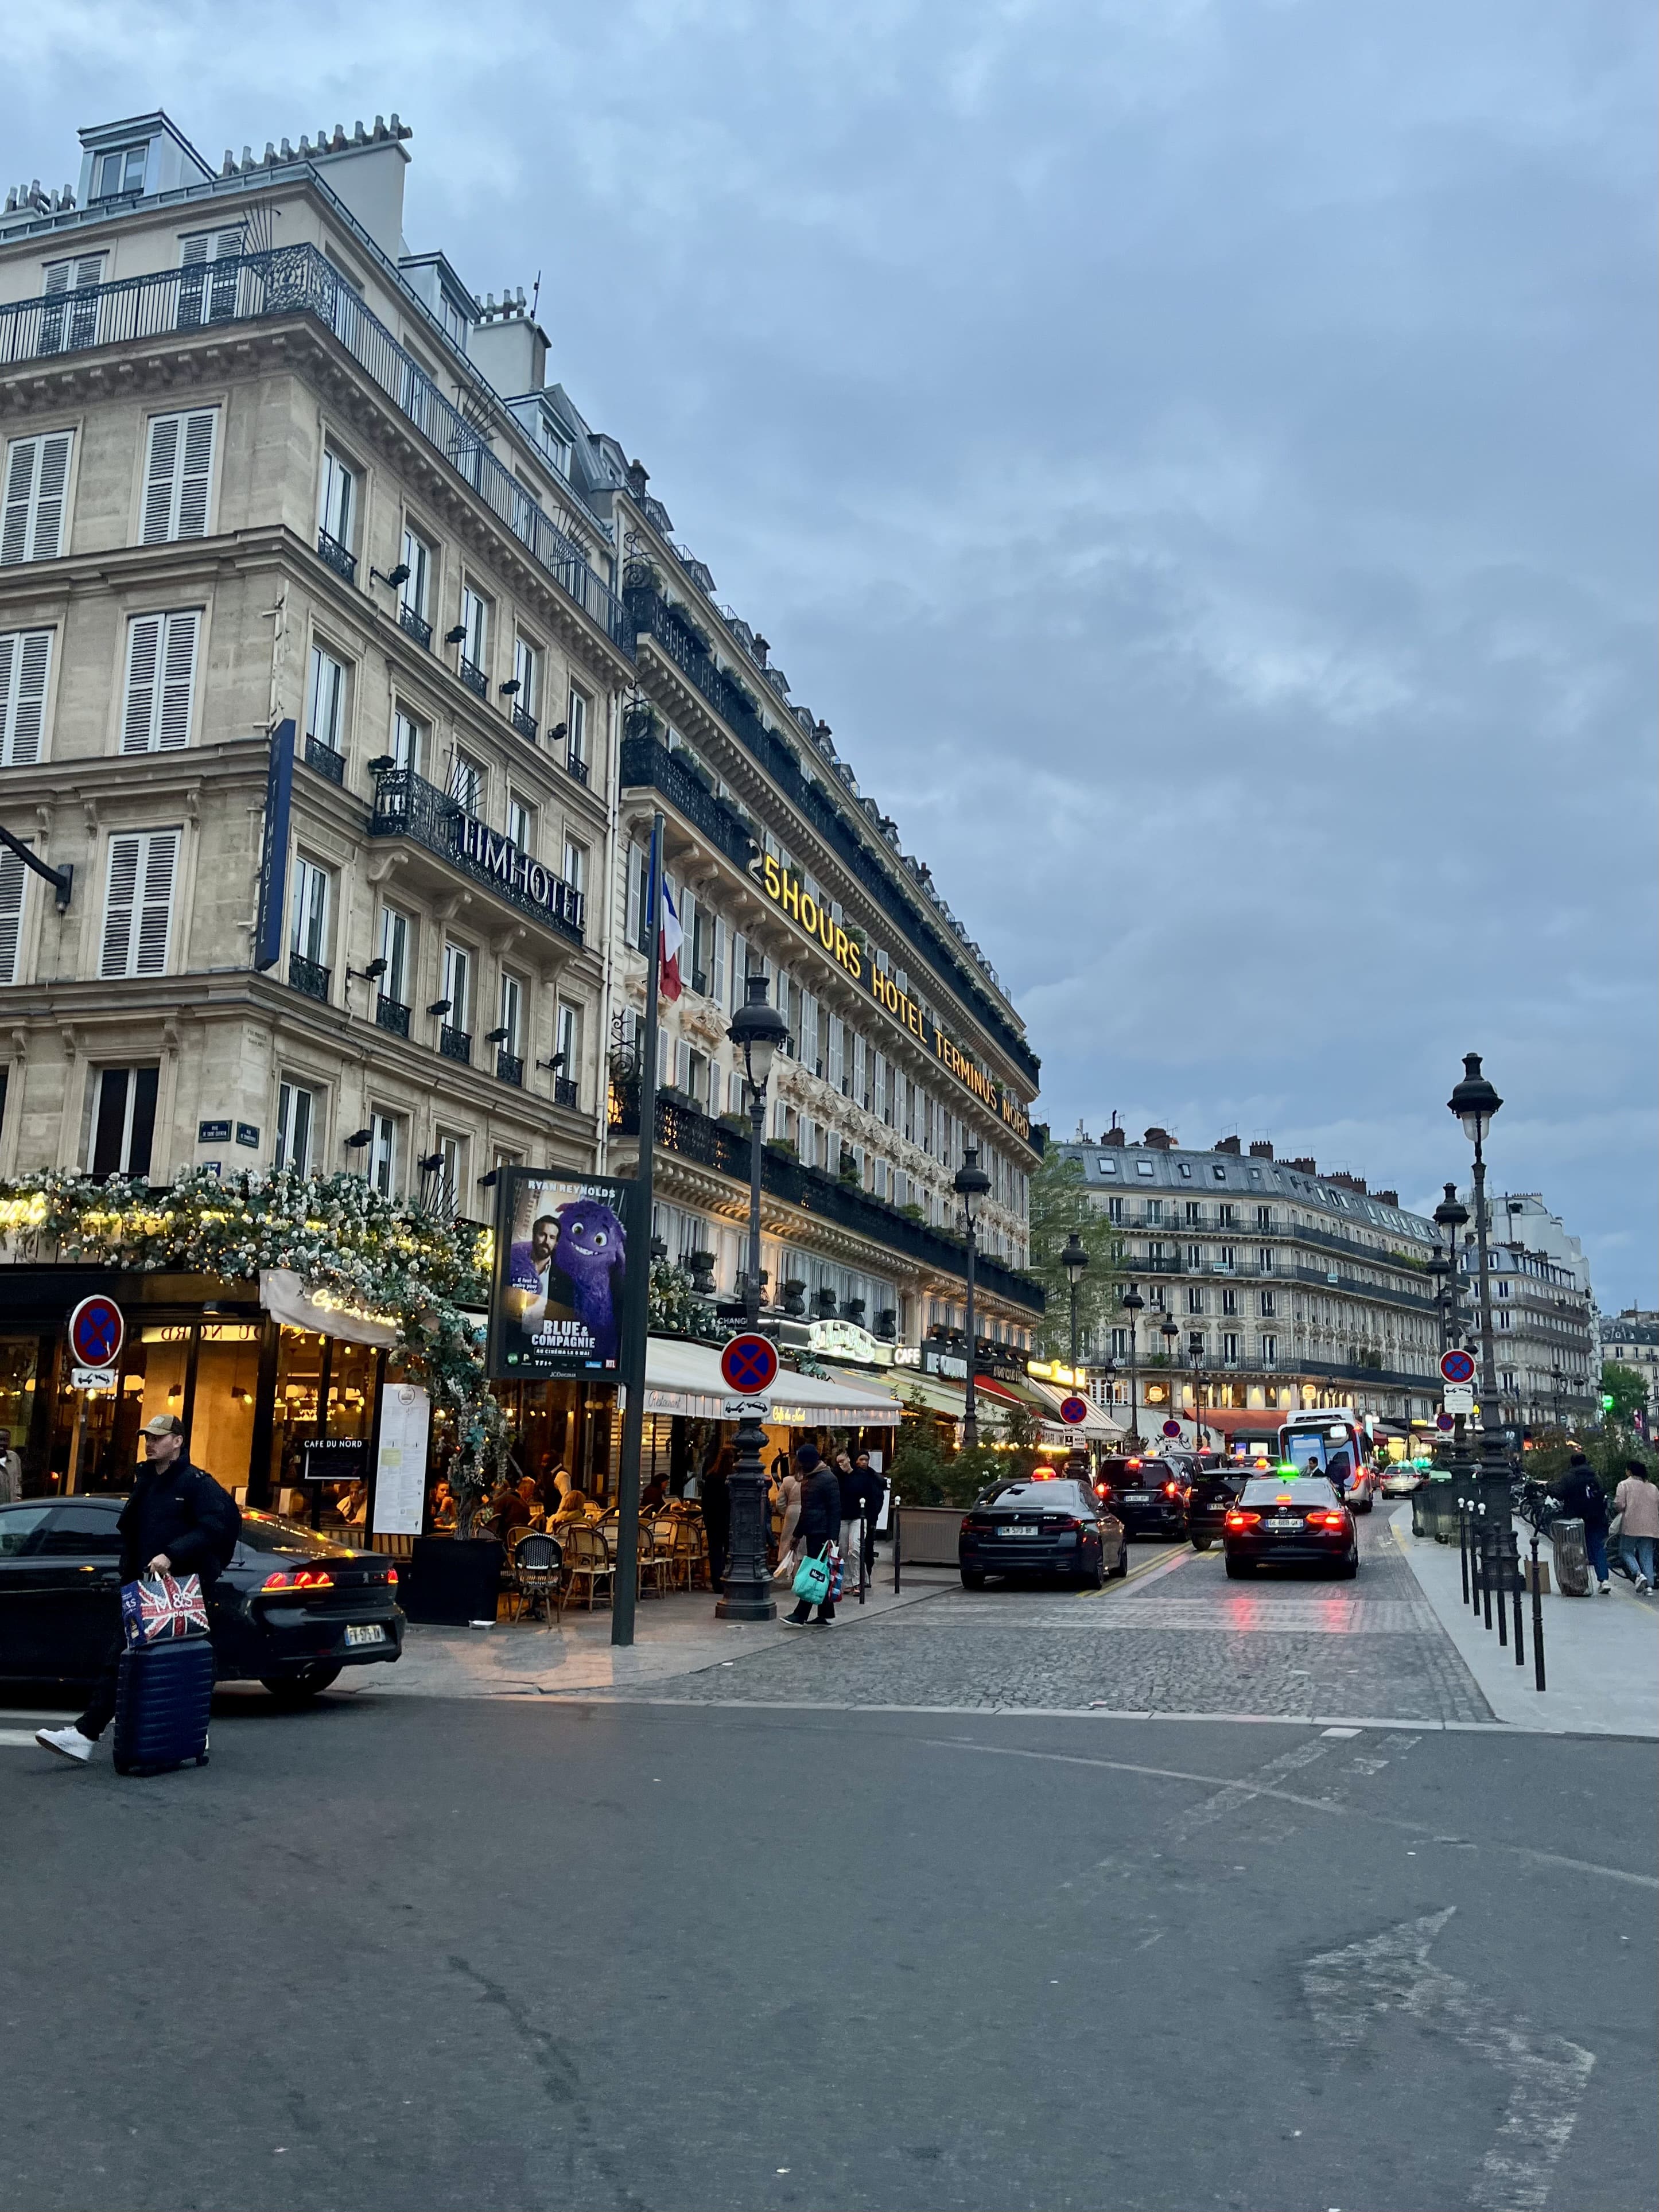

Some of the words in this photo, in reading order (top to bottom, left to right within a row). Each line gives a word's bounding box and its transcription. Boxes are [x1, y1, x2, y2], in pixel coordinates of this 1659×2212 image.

[261, 779, 277, 944] TIMHOTEL
[459, 810, 586, 932] TIMHOTEL
[748, 838, 862, 979] 25HOURS
[872, 963, 927, 1043] HOTEL
[934, 1028, 997, 1111] TERMINUS
[1003, 1098, 1029, 1141] NORD
[528, 1180, 557, 1192] RYAN
[560, 1184, 616, 1198] REYNOLDS
[531, 1334, 596, 1348] COMPAGNIE
[605, 1359, 616, 1368] RTL
[154, 1592, 193, 1613] M&S
